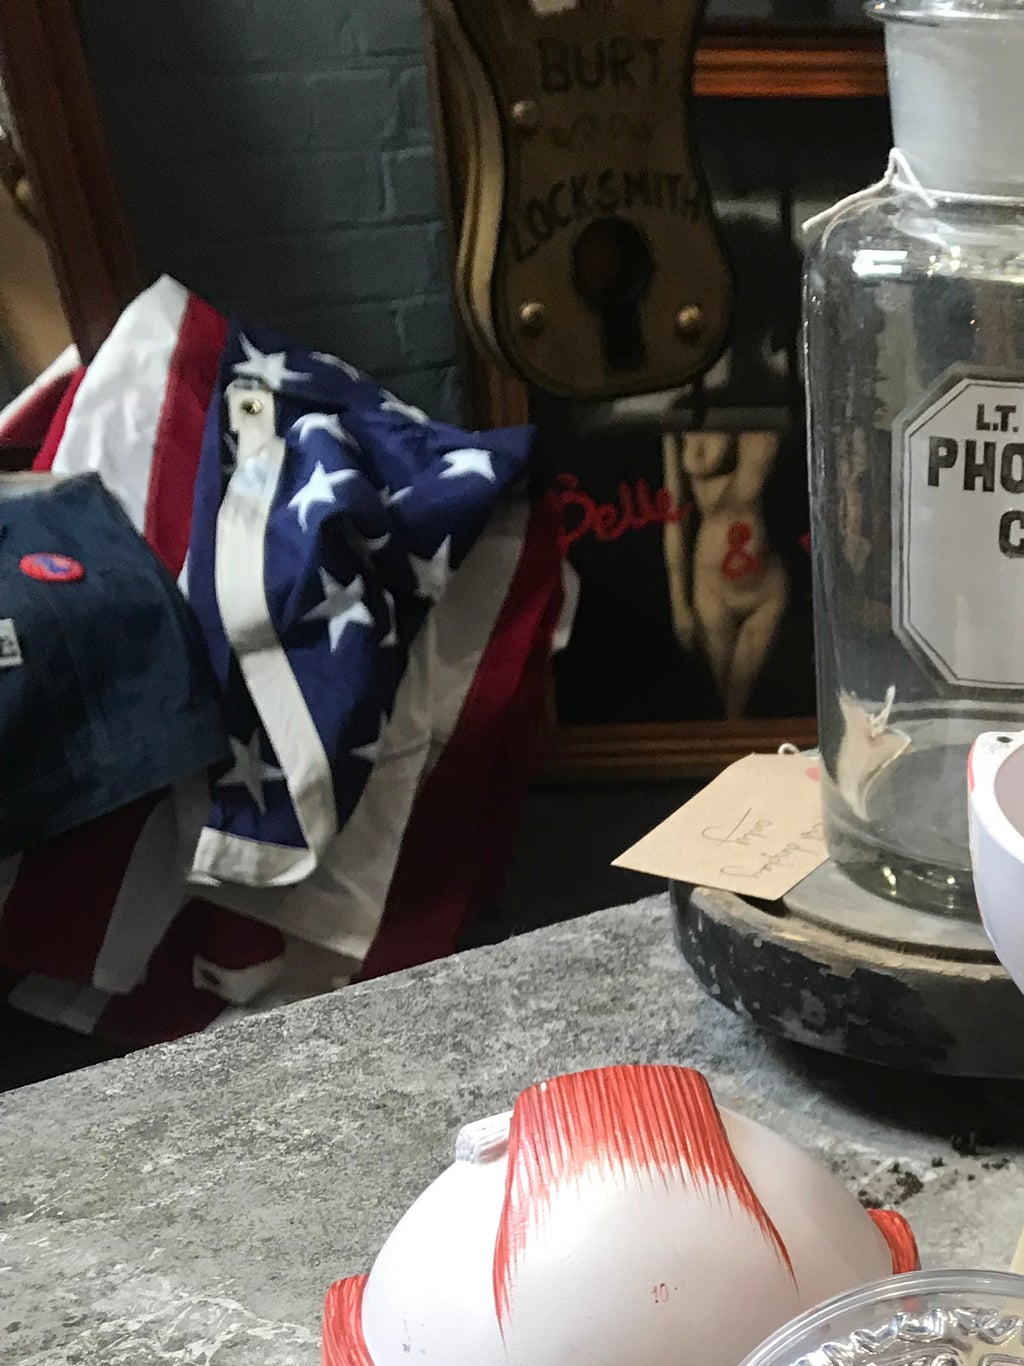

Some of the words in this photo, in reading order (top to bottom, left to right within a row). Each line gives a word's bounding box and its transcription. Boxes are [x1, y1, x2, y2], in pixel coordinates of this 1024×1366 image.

[537, 37, 664, 94] BURT
[512, 168, 706, 263] LOCKSMITH
[975, 403, 1020, 433] L.T.
